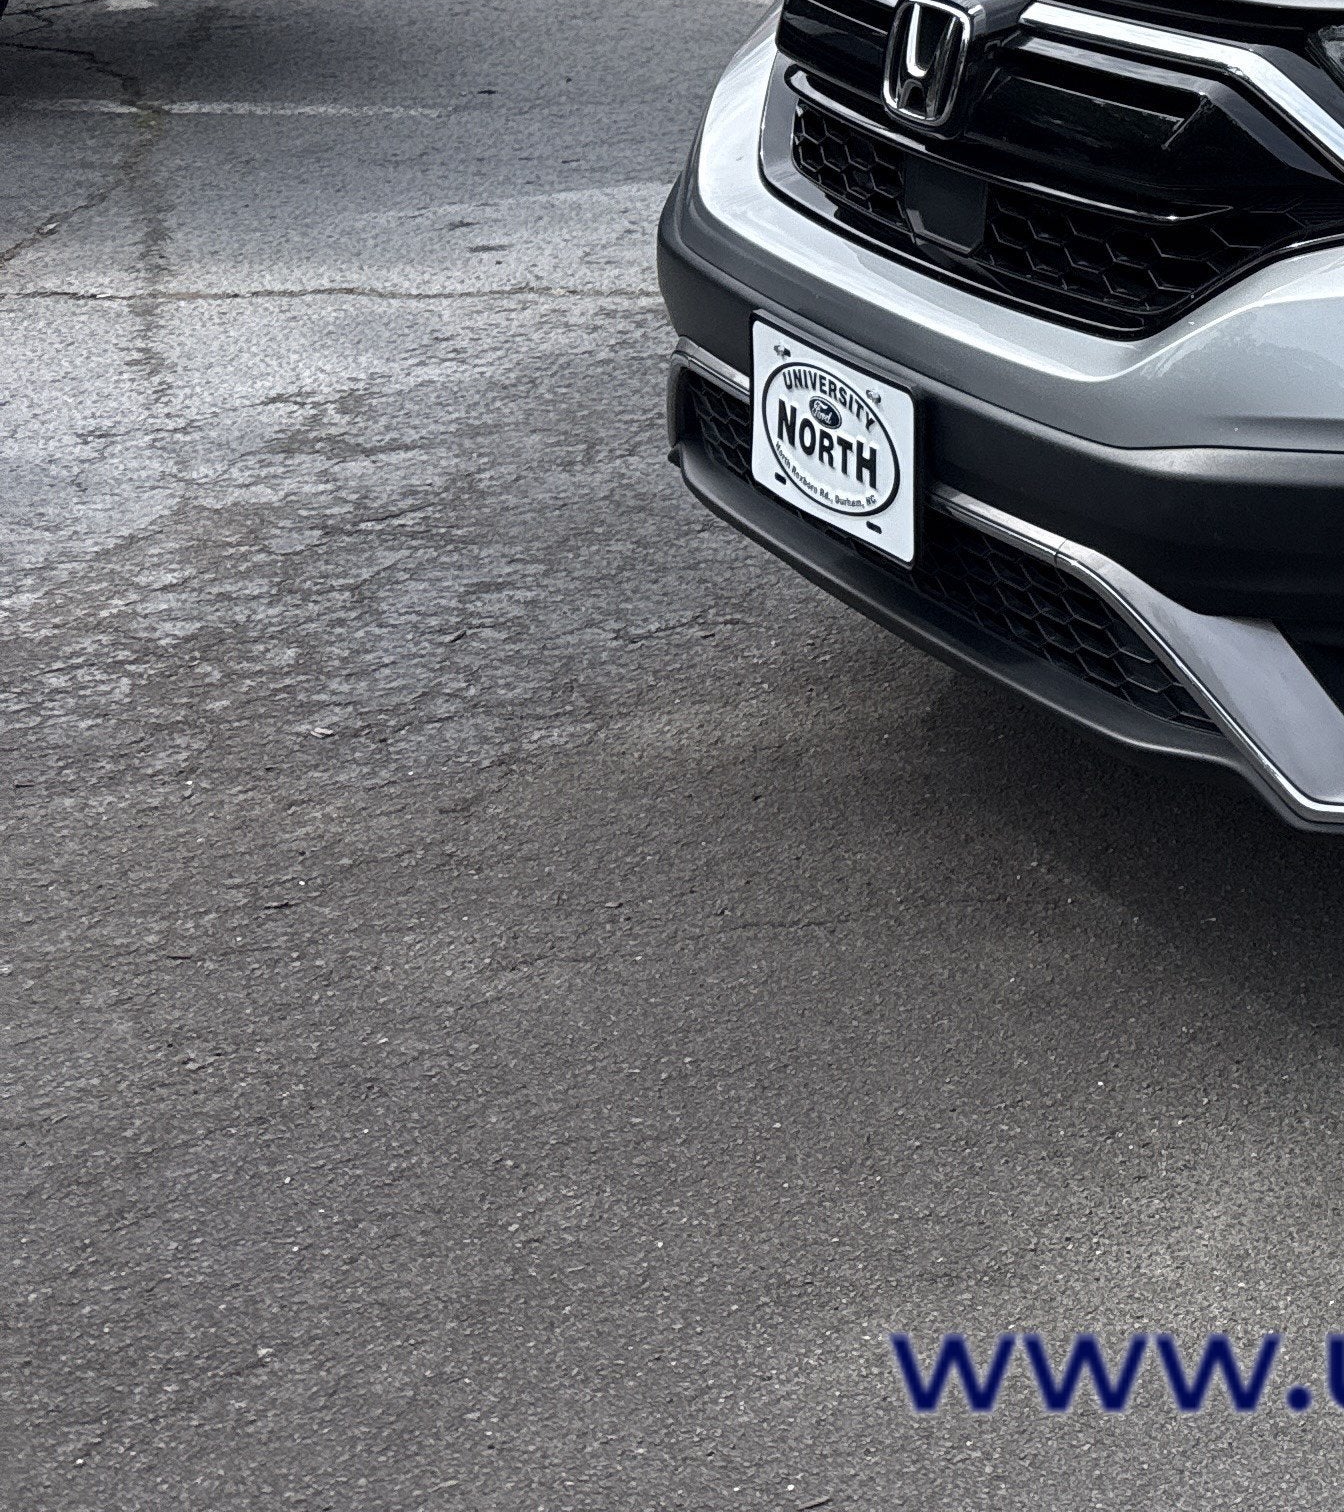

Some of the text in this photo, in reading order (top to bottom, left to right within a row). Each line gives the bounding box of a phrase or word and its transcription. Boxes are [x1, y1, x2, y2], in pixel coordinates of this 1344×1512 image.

[782, 370, 878, 432] UNIVERSITY
[811, 399, 833, 425] Ford
[777, 397, 877, 490] NORTH
